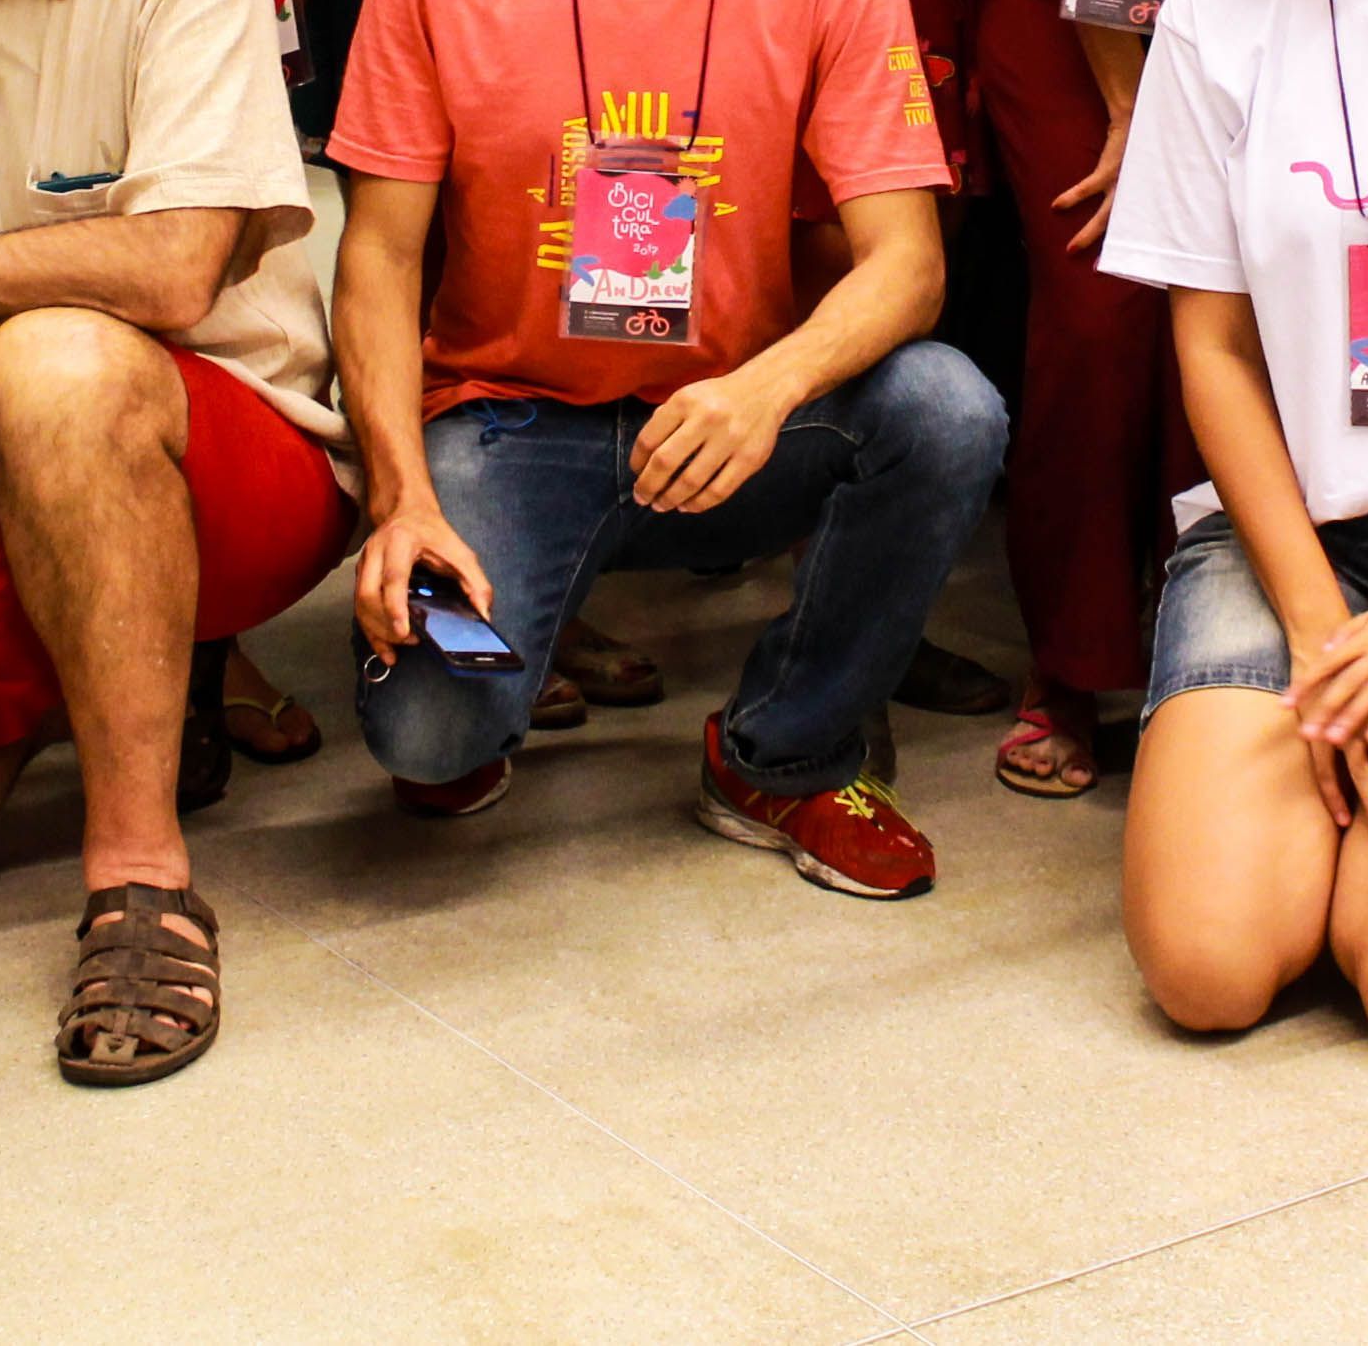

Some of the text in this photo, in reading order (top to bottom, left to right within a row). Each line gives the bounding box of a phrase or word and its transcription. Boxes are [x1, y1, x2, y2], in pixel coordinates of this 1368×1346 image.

[607, 182, 654, 208] BICI
[622, 207, 660, 225] CUL
[633, 243, 659, 256] 2017
